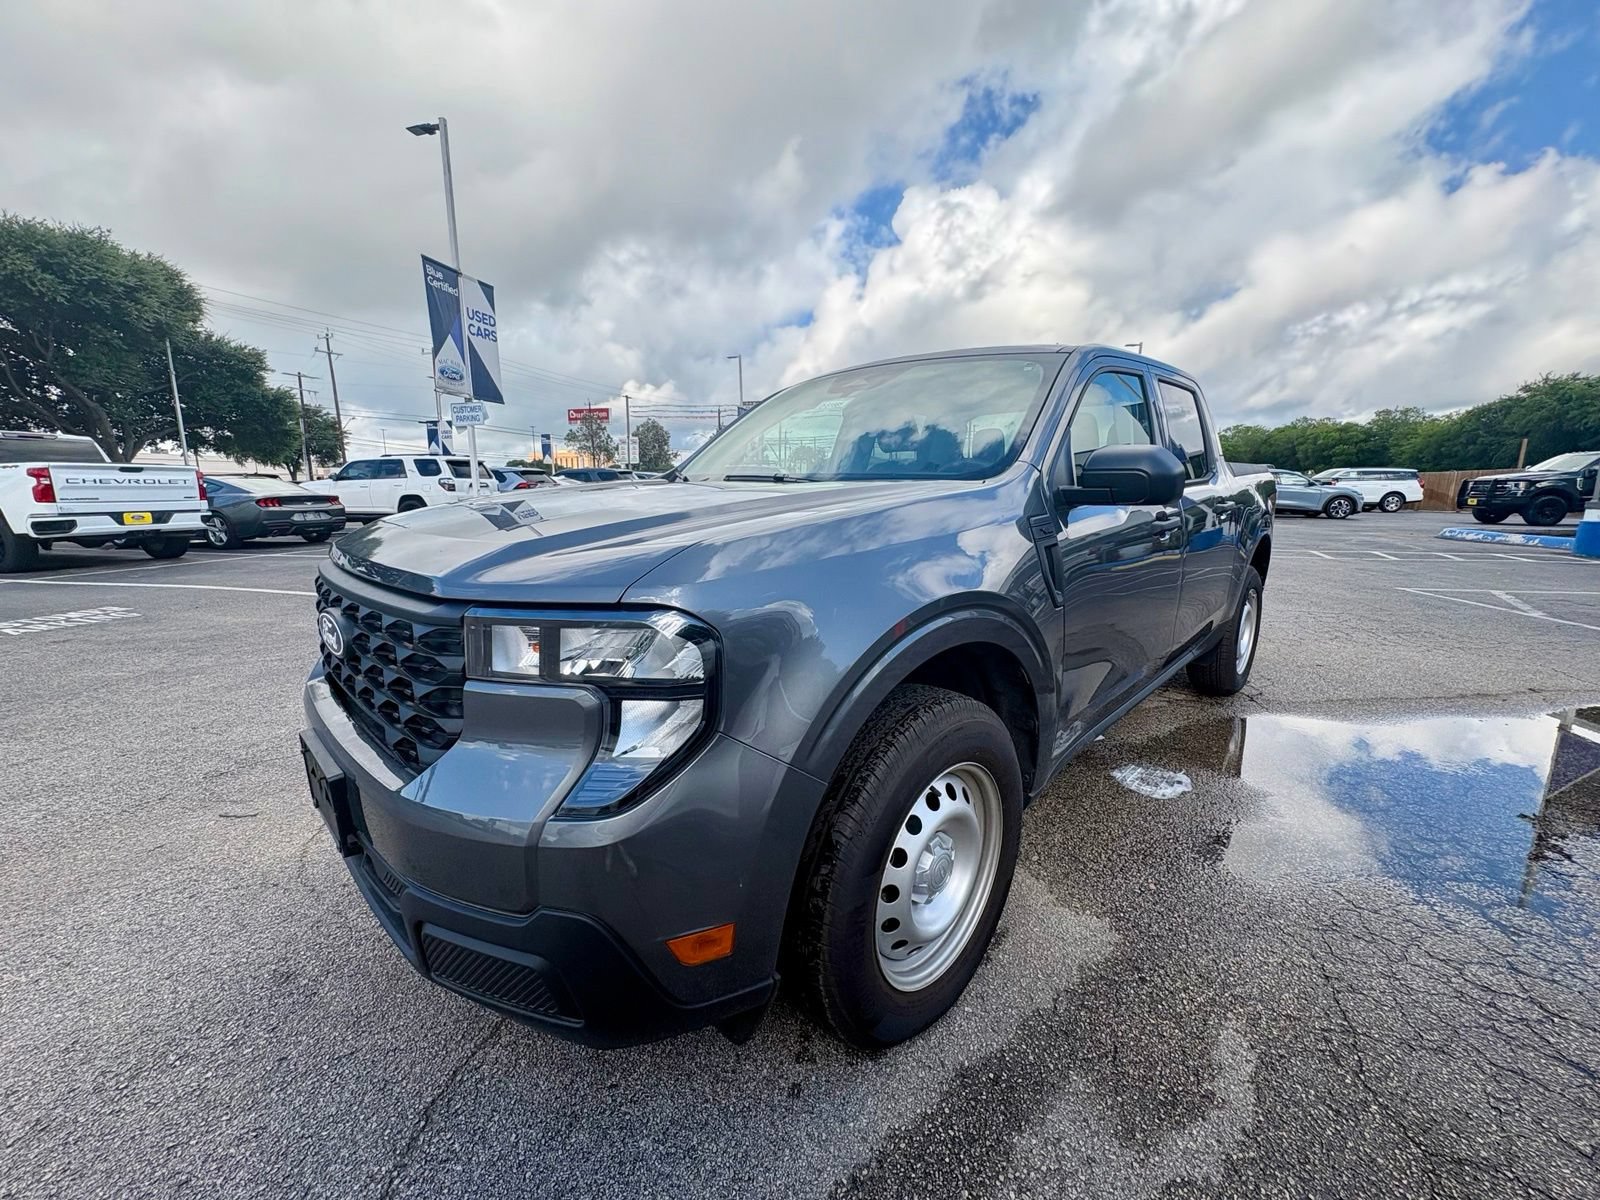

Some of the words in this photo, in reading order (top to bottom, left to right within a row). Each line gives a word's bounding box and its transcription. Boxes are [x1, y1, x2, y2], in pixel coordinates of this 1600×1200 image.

[425, 264, 443, 279] Blue
[426, 276, 459, 297] Certified
[466, 307, 497, 327] USED
[467, 323, 498, 342] CARS
[442, 367, 461, 381] Ford
[452, 405, 482, 414] CUSTOMER
[322, 617, 338, 650] Ford
